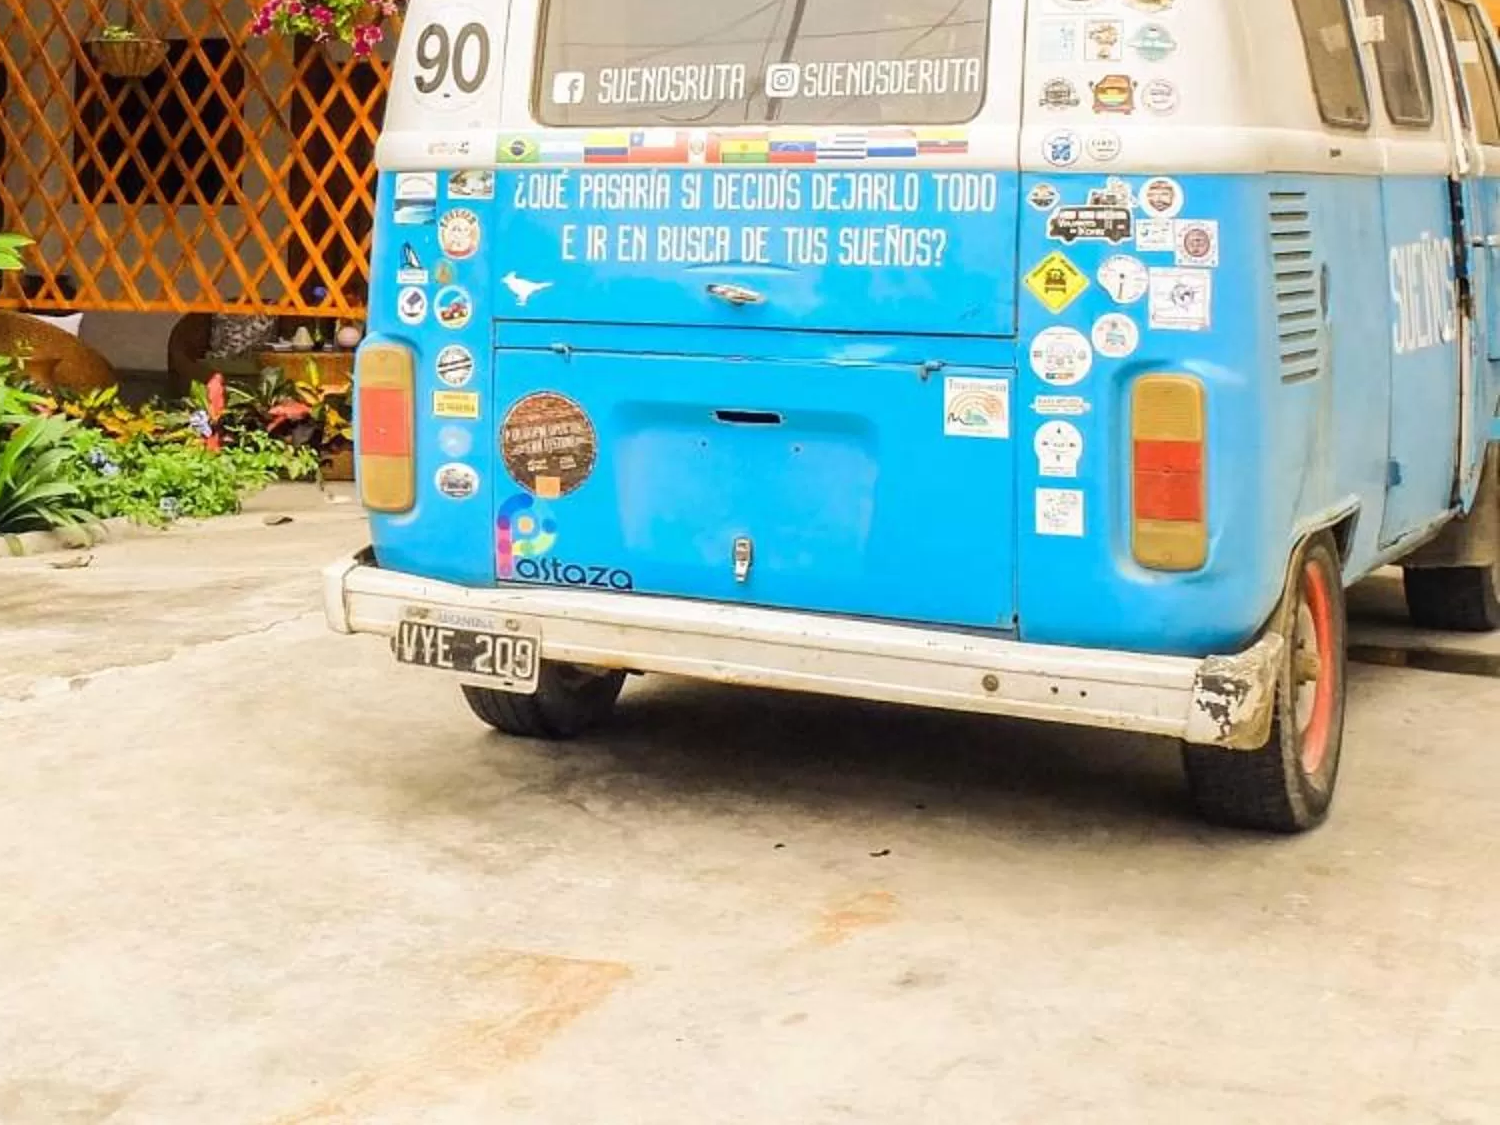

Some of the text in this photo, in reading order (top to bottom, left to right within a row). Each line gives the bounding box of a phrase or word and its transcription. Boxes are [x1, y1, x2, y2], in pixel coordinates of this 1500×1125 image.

[414, 22, 490, 94] 90
[803, 58, 981, 97] SUENOSDERUTA
[597, 64, 745, 104] SUENOSRUTA
[514, 168, 997, 212] ¿QUÉ PASARÍA SI DECIDÍS DEJARLO TODO
[562, 224, 948, 267] E IR EN BUSCA DE TUS SUEÑOS?
[402, 623, 533, 678] VYE 209
